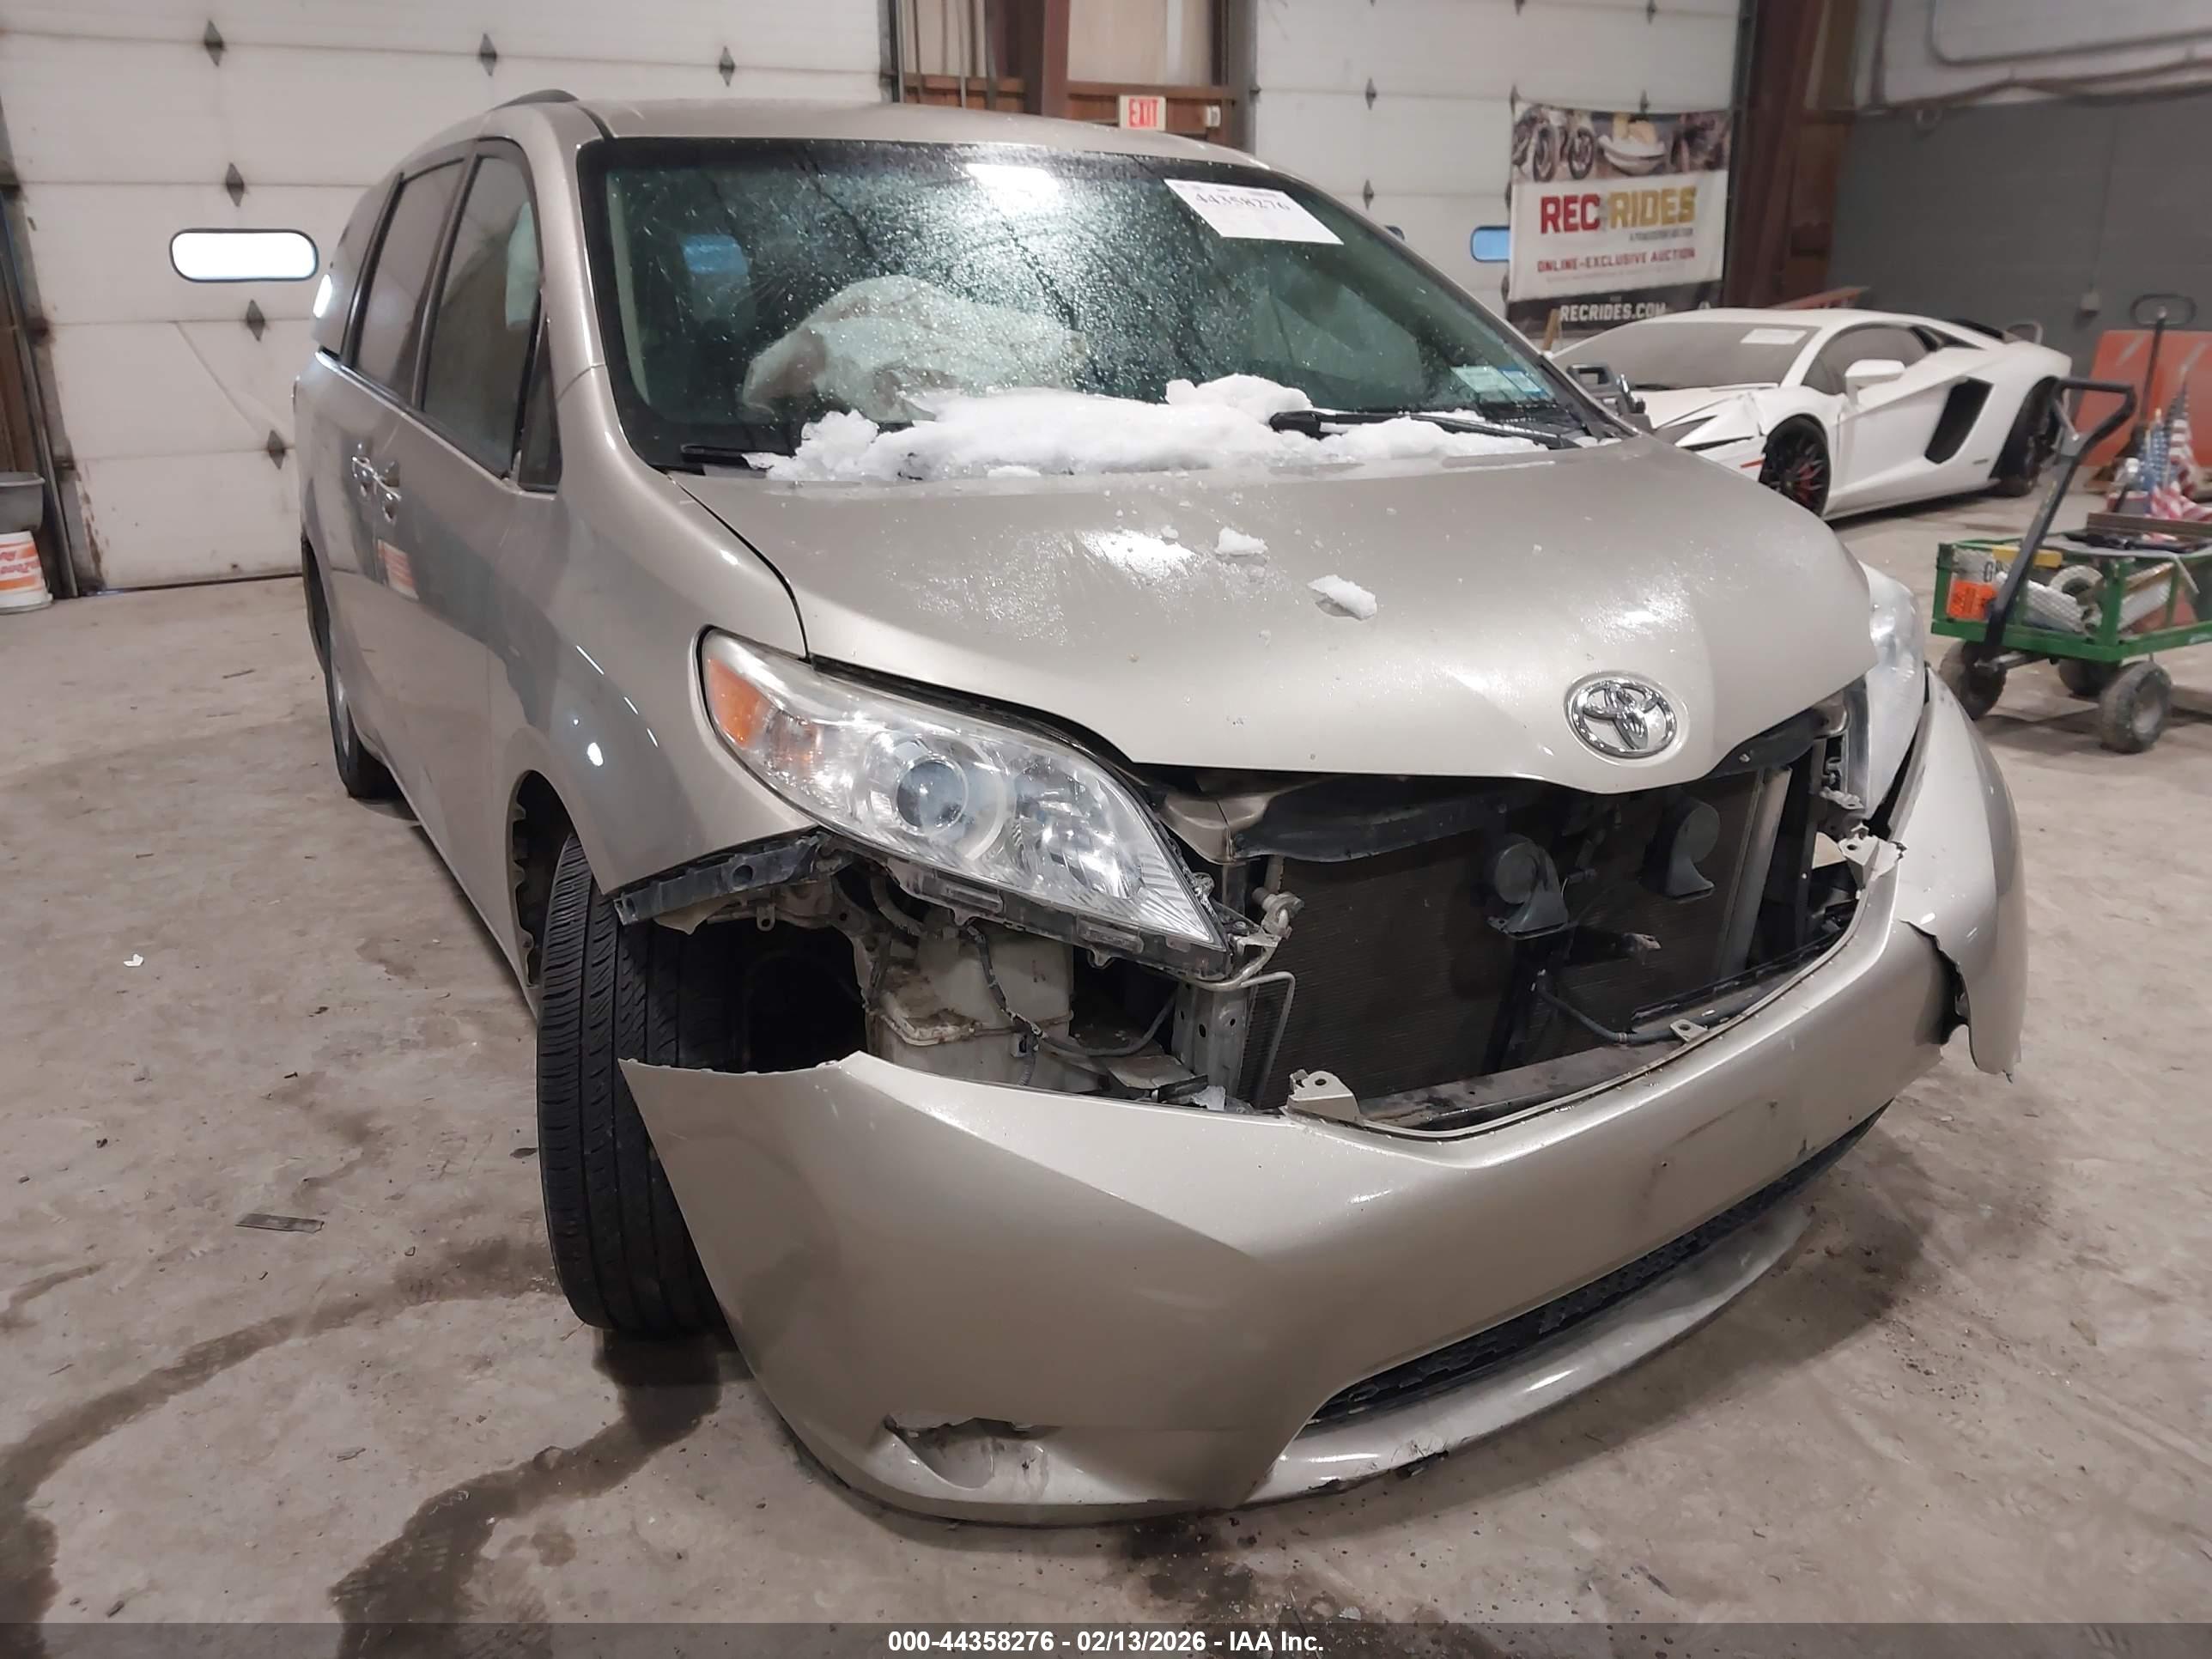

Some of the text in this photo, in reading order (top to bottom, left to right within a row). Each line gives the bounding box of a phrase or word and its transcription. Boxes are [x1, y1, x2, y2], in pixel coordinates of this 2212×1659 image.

[1128, 97, 1159, 128] EXIT
[1540, 185, 1697, 234] REC RIDES
[1537, 247, 1696, 272] ONLINE-EXCLUSIVE AUCTION
[1559, 301, 1667, 322] RECRIDES.COM
